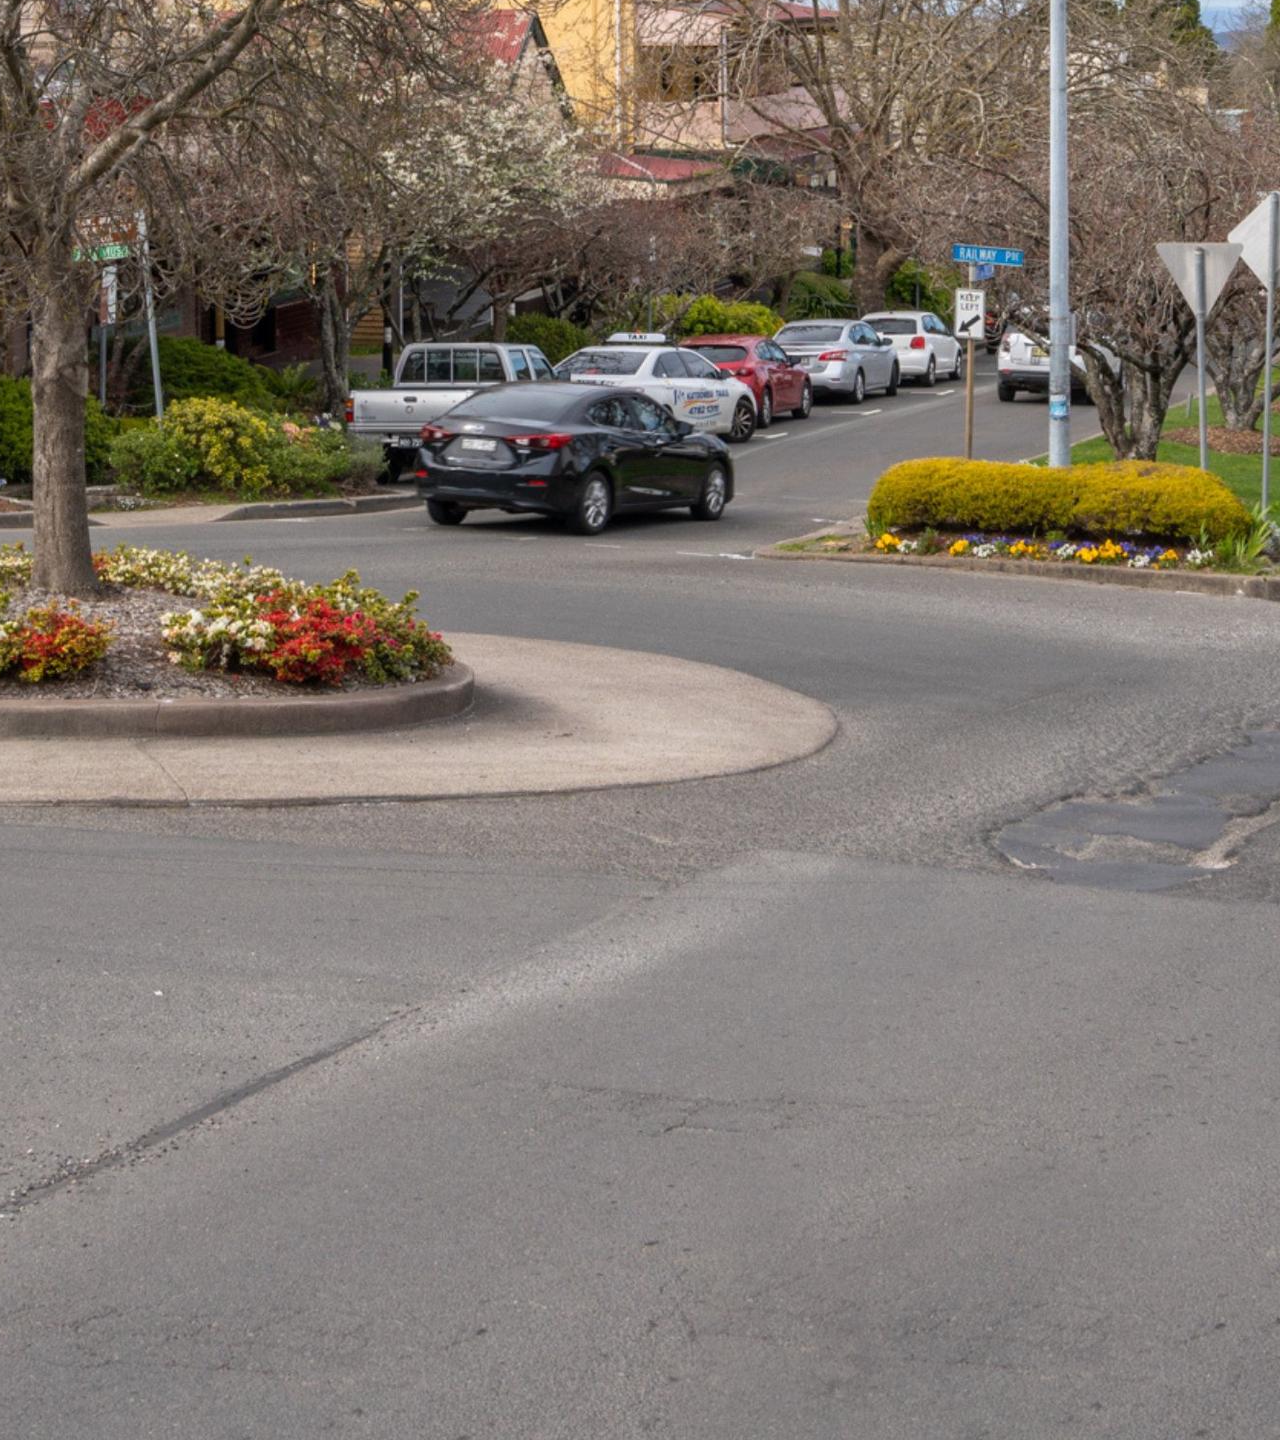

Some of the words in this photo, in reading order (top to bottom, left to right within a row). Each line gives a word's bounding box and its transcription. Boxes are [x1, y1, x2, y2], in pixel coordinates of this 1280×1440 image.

[959, 247, 998, 262] RAILWAY
[960, 293, 980, 301] KEEP
[960, 303, 979, 311] LEFT
